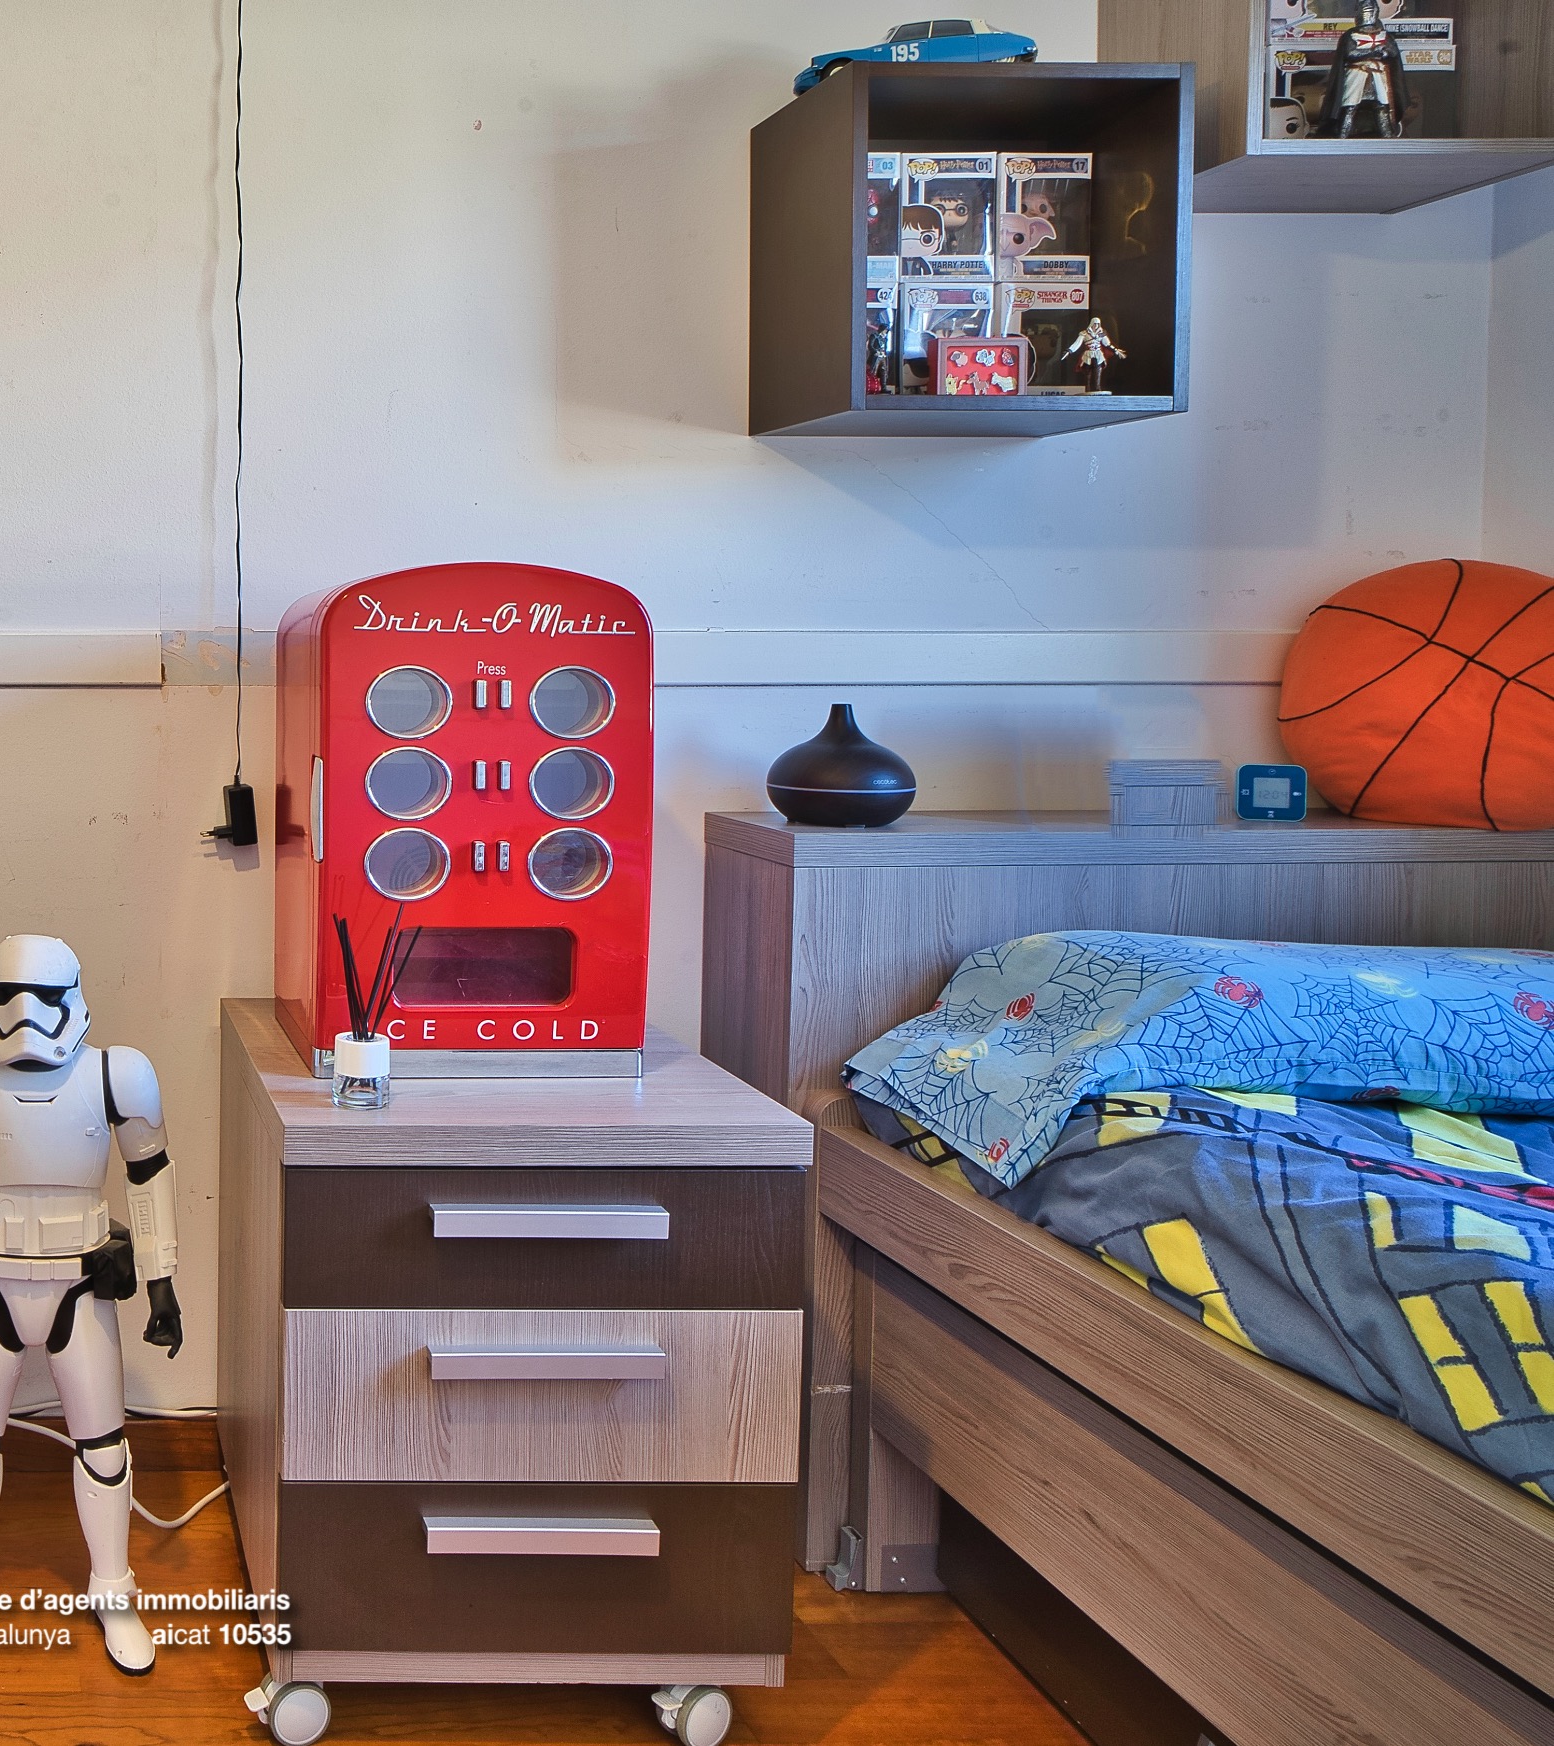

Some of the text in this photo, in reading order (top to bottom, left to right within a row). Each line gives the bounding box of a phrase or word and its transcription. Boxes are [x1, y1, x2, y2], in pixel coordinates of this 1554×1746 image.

[890, 43, 920, 62] 195
[882, 161, 894, 170] 03
[908, 161, 938, 176] POP!
[978, 162, 988, 170] 01
[1006, 161, 1035, 175] POP!
[1074, 162, 1086, 170] 17
[932, 260, 985, 268] HARRY POTTE
[1044, 260, 1070, 268] DOBBY
[477, 661, 507, 676] Press
[386, 1019, 599, 1041] CE COLD
